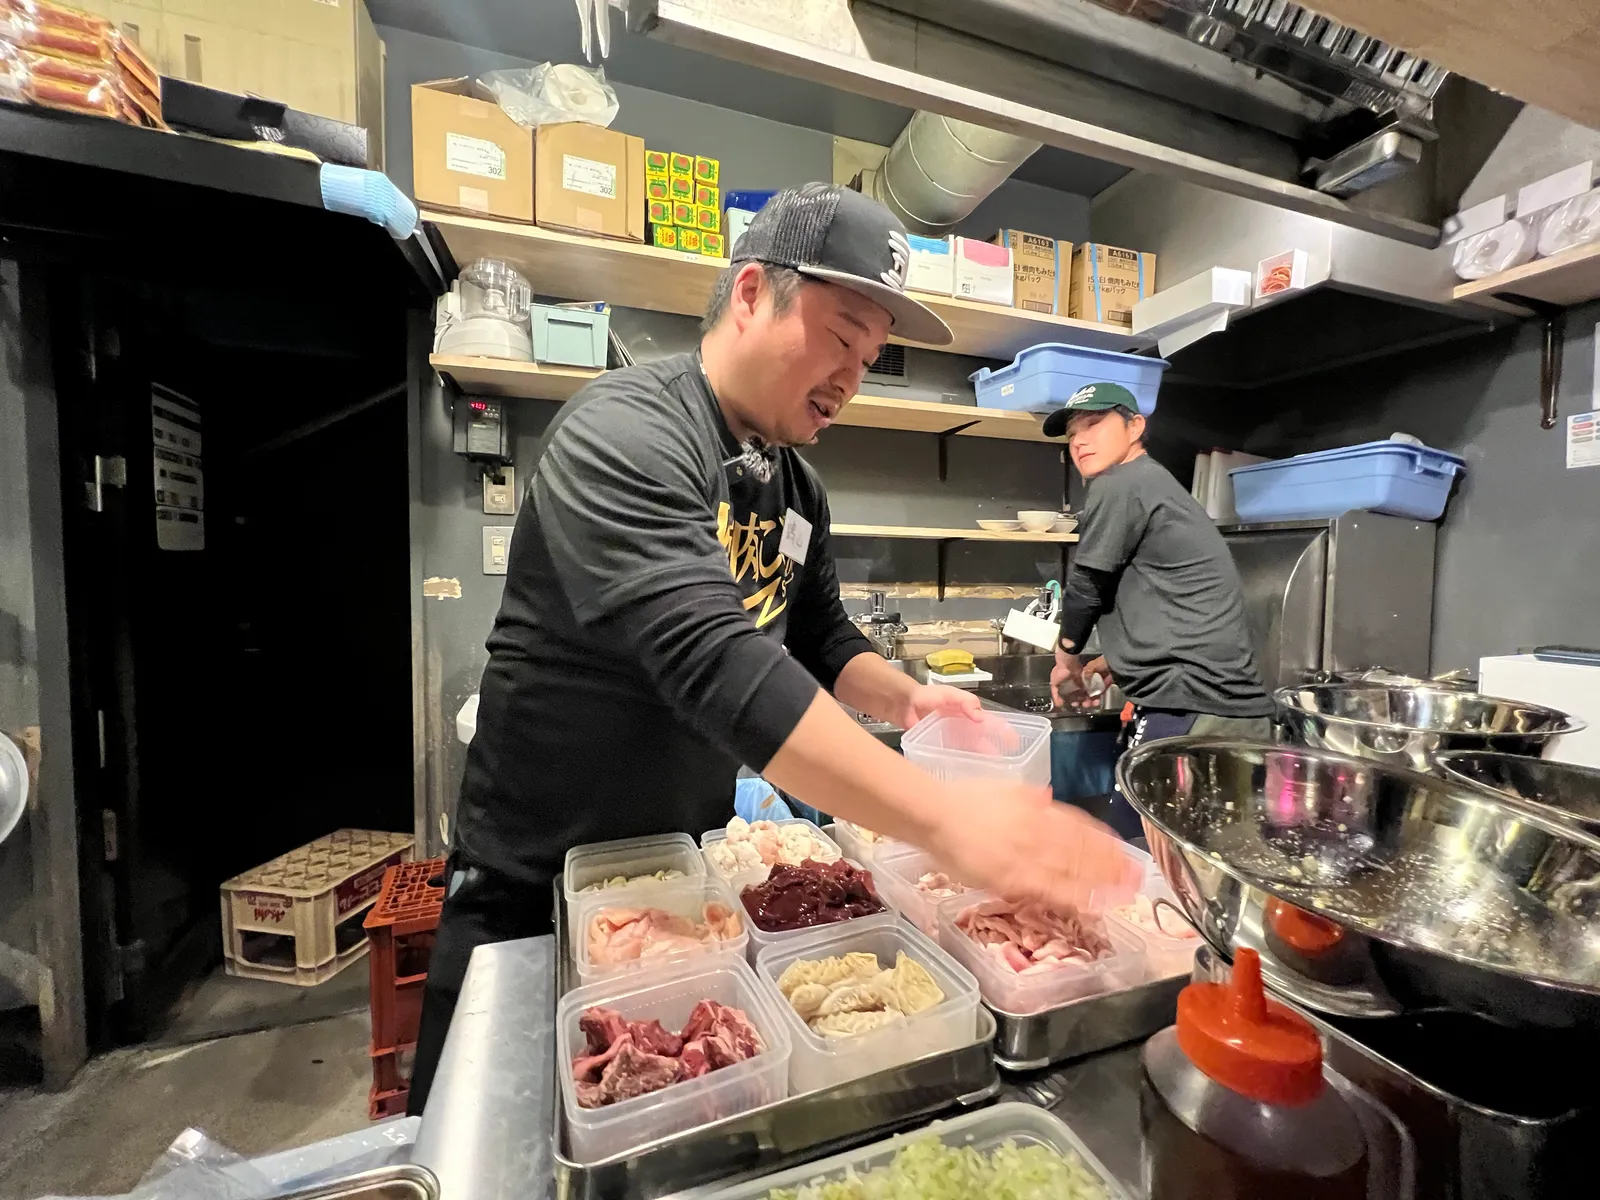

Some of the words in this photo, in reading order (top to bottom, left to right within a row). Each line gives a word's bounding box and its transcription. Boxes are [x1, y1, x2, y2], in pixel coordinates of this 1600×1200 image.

[488, 166, 502, 176] 302
[600, 185, 613, 195] 302
[1027, 237, 1050, 247] A6163
[1112, 251, 1134, 260] A6163
[1088, 276, 1106, 284] ISEI
